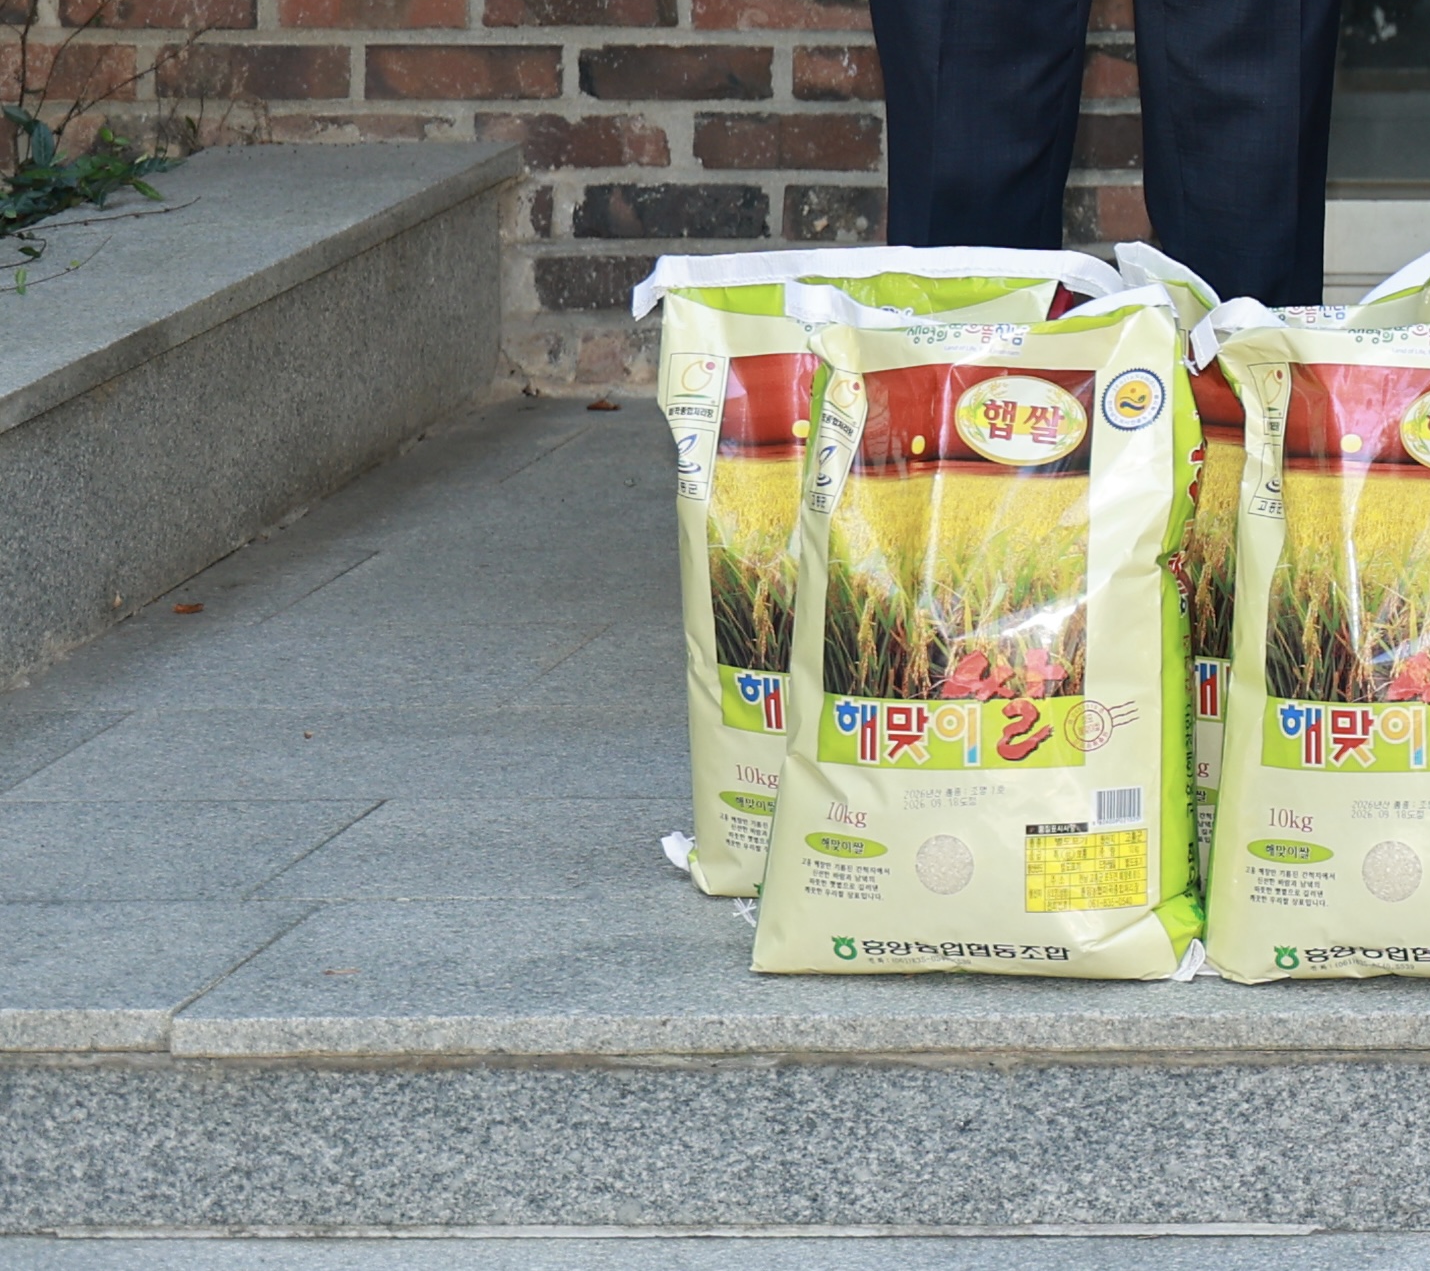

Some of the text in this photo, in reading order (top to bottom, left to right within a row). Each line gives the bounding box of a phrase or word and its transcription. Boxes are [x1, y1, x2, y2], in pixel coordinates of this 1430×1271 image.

[982, 398, 1066, 446] 햅쌀
[835, 699, 979, 764] 해맞이
[941, 648, 1068, 761] 쌀
[1278, 703, 1425, 767] 해맞이
[736, 763, 779, 789] 10kg
[826, 801, 868, 828] 10kg
[1267, 808, 1314, 833] 10kg
[820, 837, 864, 854] 해맞이쌀
[1265, 842, 1310, 859] 해맞이쌀
[861, 939, 1070, 962] 흥양농업협동조합
